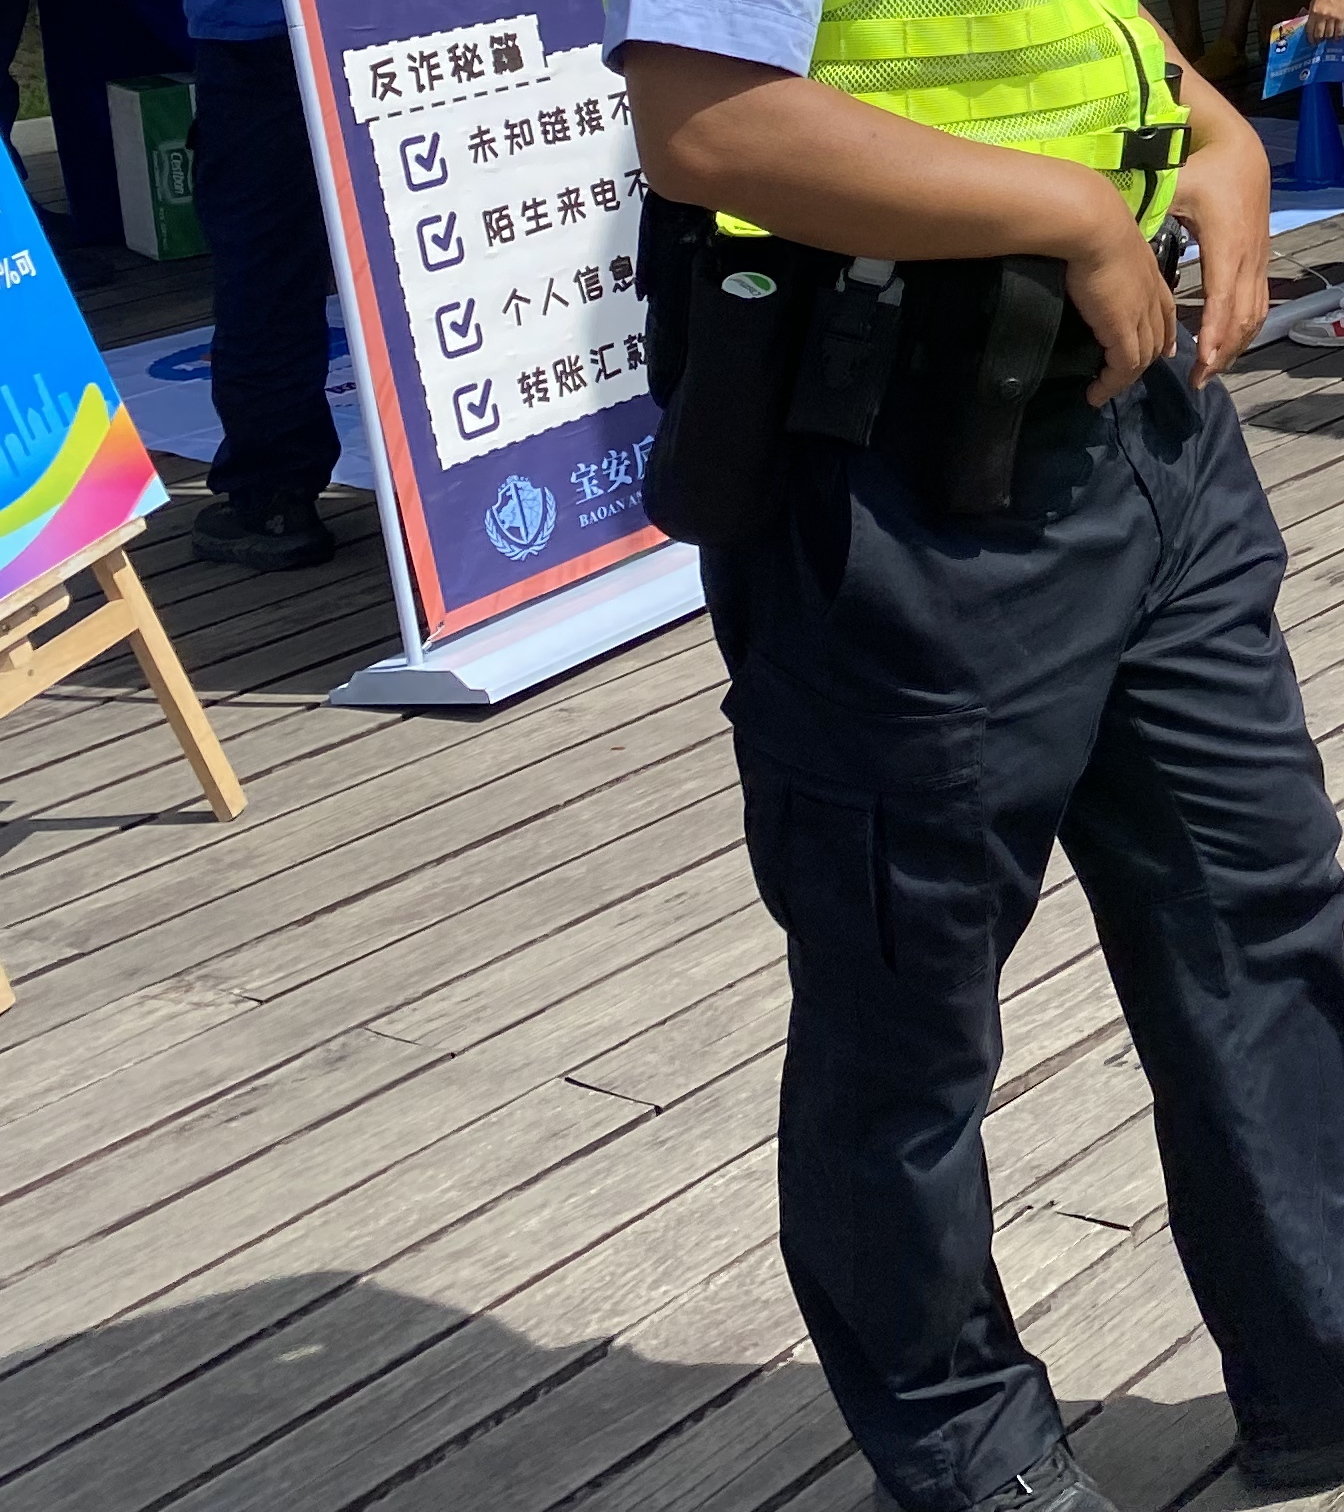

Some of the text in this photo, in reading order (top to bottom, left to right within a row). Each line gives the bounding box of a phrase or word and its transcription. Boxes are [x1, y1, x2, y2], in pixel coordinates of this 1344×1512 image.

[467, 90, 631, 165] 未知链接不
[481, 167, 650, 248] 陌生来电不
[501, 254, 636, 327] 个人信息
[578, 497, 627, 528] BAOAN
